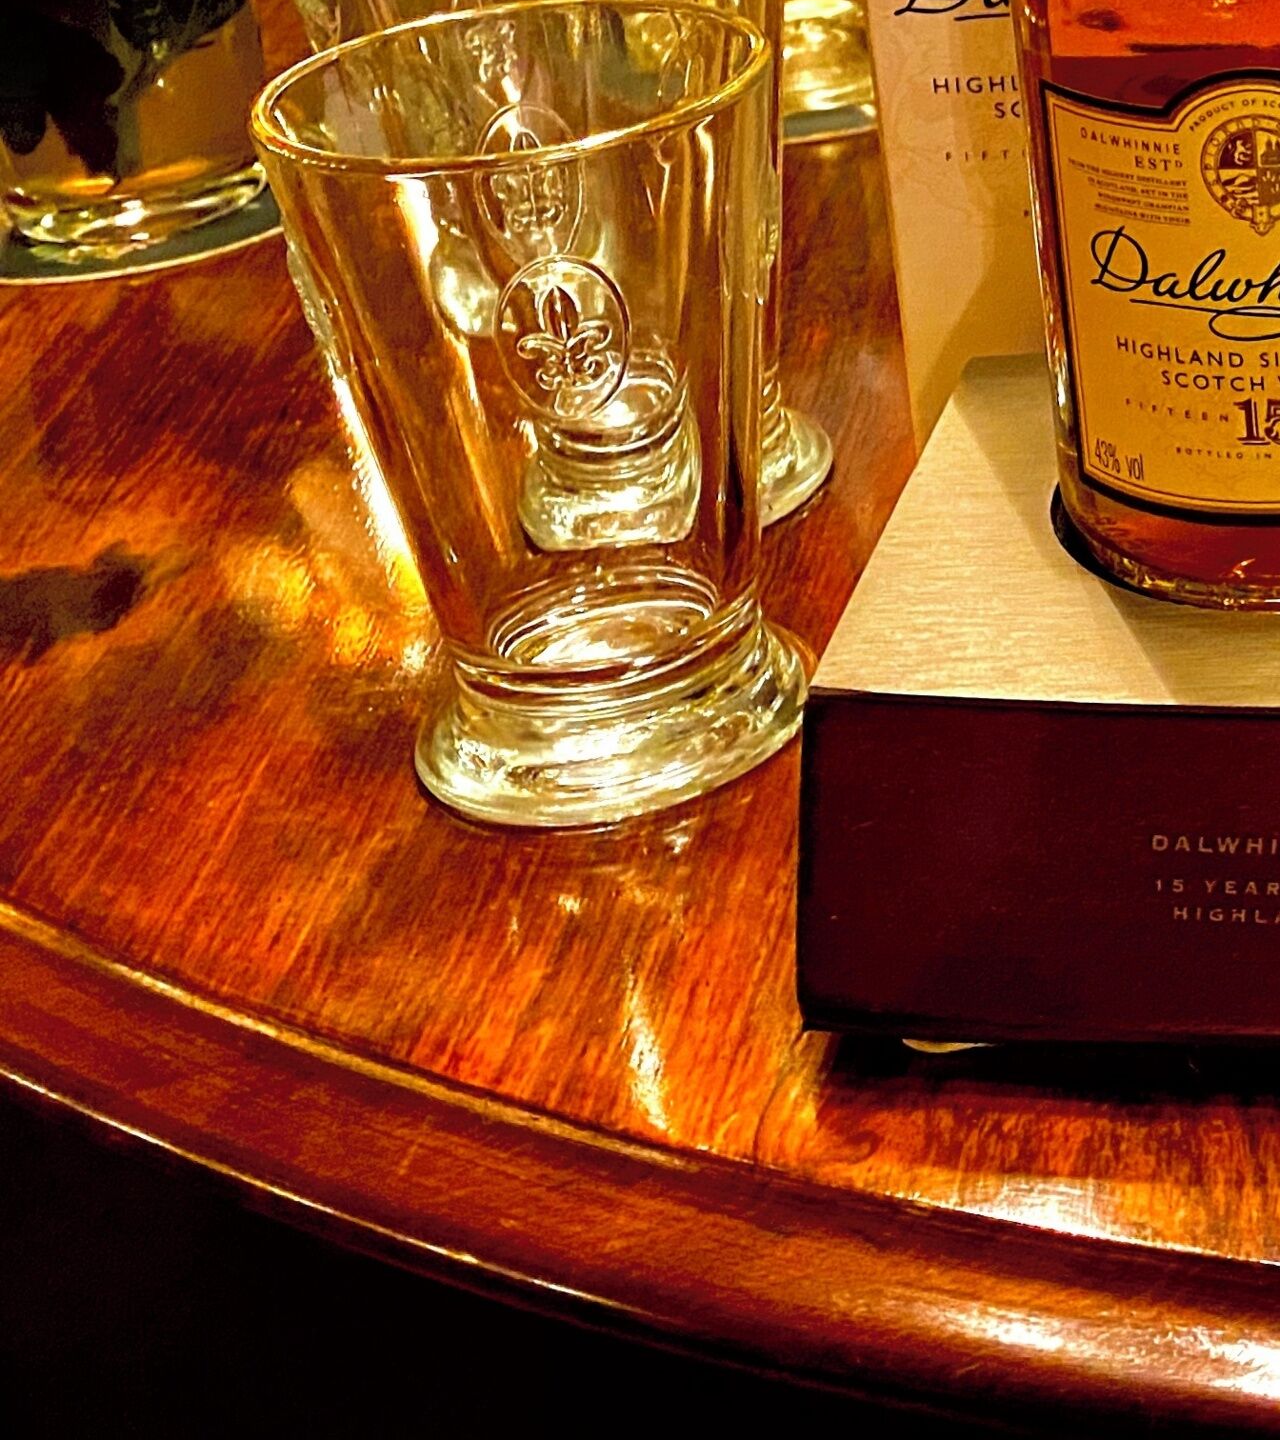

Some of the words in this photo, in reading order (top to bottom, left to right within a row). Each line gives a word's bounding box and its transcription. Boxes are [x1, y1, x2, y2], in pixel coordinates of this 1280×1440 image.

[1081, 126, 1180, 155] DALWHINNIE
[1116, 335, 1243, 368] HIGHLAND
[1162, 370, 1264, 391] SCOTCH
[1125, 398, 1229, 422] FIFTEEN
[1094, 437, 1121, 474] 43%
[1125, 454, 1145, 480] vol
[1156, 880, 1184, 892] 15
[1205, 880, 1280, 895] YEAR
